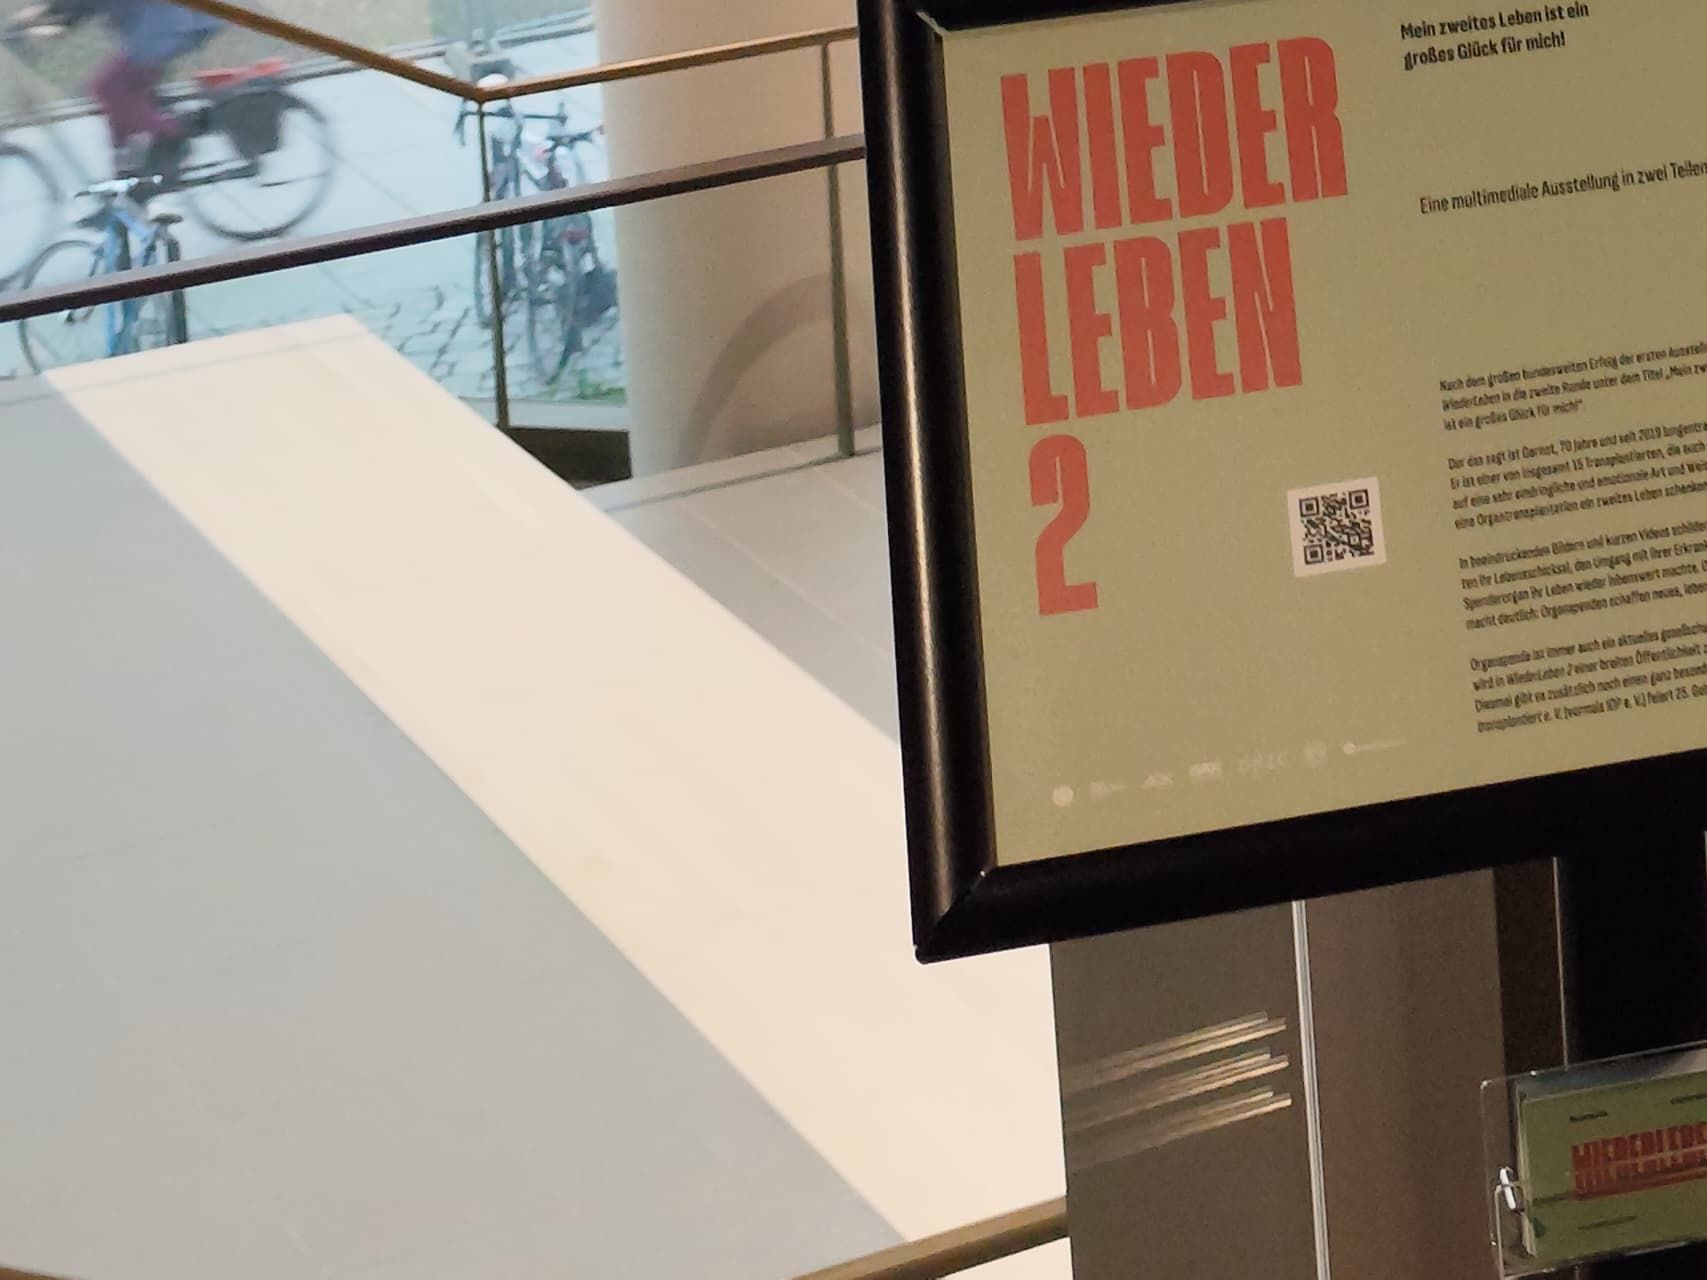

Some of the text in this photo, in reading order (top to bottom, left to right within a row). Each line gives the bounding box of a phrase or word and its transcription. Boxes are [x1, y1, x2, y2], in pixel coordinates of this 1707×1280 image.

[1399, 0, 1589, 40] Mein zweites Leben ist ein
[1403, 29, 1566, 71] großes Glück für mich!
[1001, 36, 1347, 241] WIEDER
[1419, 196, 1449, 214] Eine
[1451, 182, 1538, 209] multimediale
[1541, 172, 1620, 196] Ausstellung
[1620, 169, 1635, 186] in
[1636, 163, 1668, 184] zwei
[1014, 217, 1302, 425] LEBEN
[1028, 434, 1097, 616] 2
